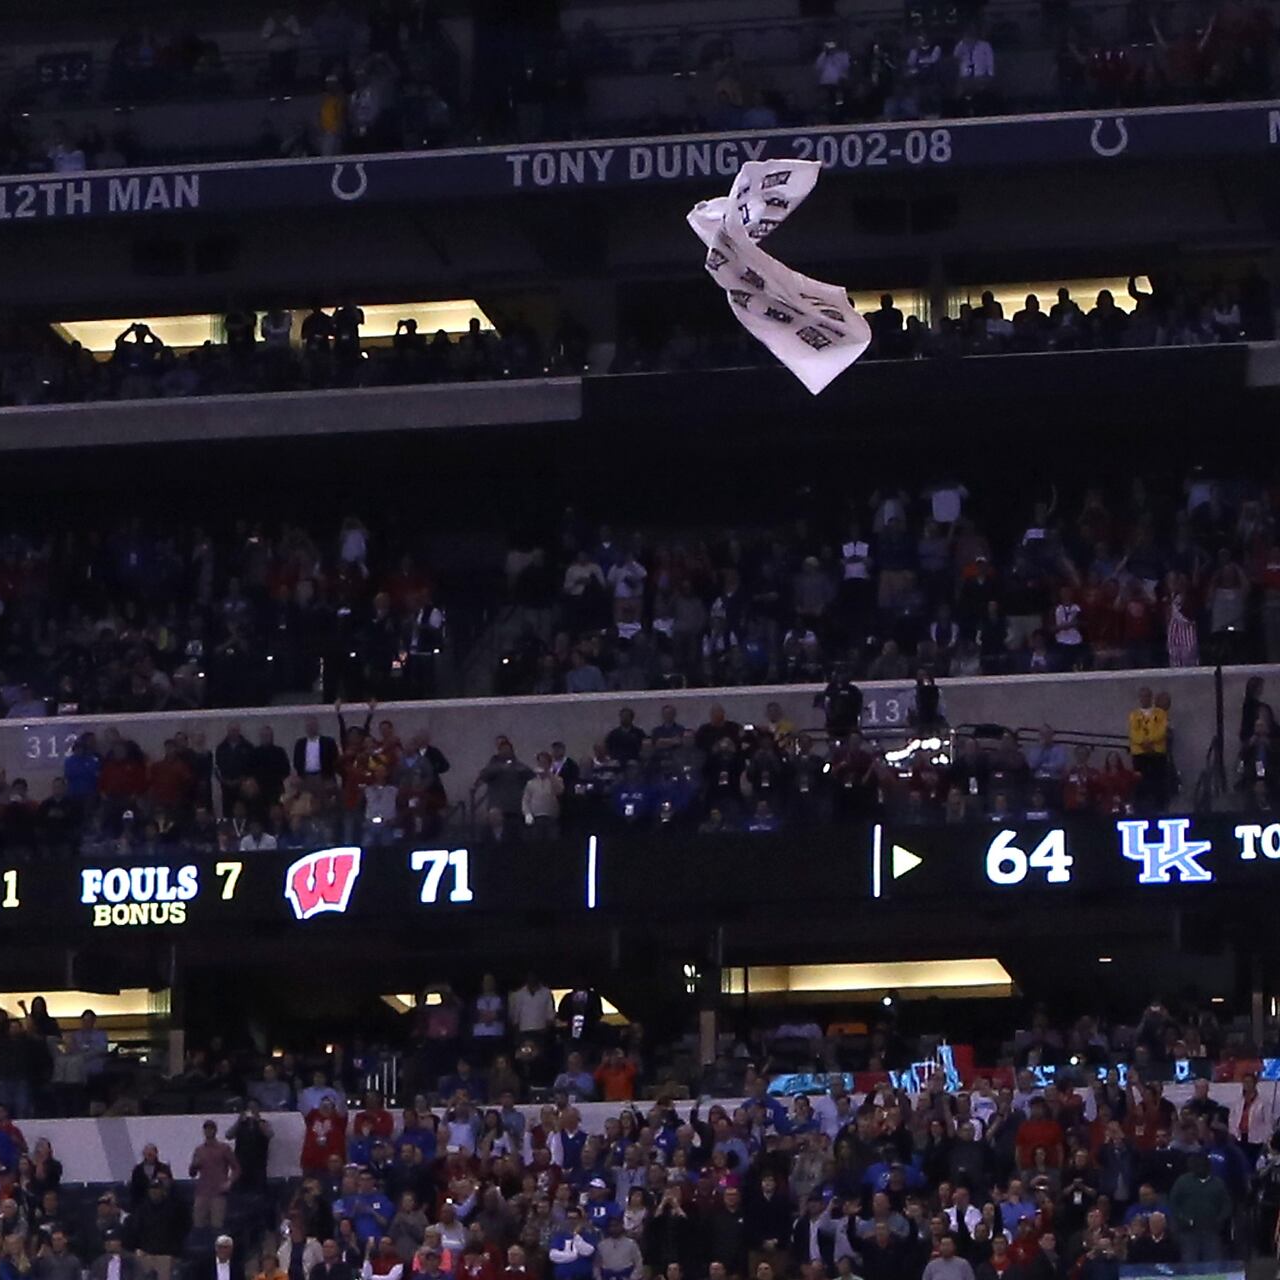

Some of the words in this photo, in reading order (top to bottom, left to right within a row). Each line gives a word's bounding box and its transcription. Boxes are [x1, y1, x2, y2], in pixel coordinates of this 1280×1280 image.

[506, 149, 614, 187] TONY
[792, 128, 953, 169] 2002-08
[108, 174, 200, 212] MAN
[865, 700, 900, 722] 13
[25, 733, 78, 758] 312
[986, 829, 1073, 884] 64
[1117, 819, 1213, 883] UK
[2, 870, 20, 907] 1
[81, 865, 198, 903] FOULS
[215, 862, 242, 899] 7
[288, 850, 358, 915] W
[410, 849, 473, 902] 71
[93, 902, 186, 927] BONUS
